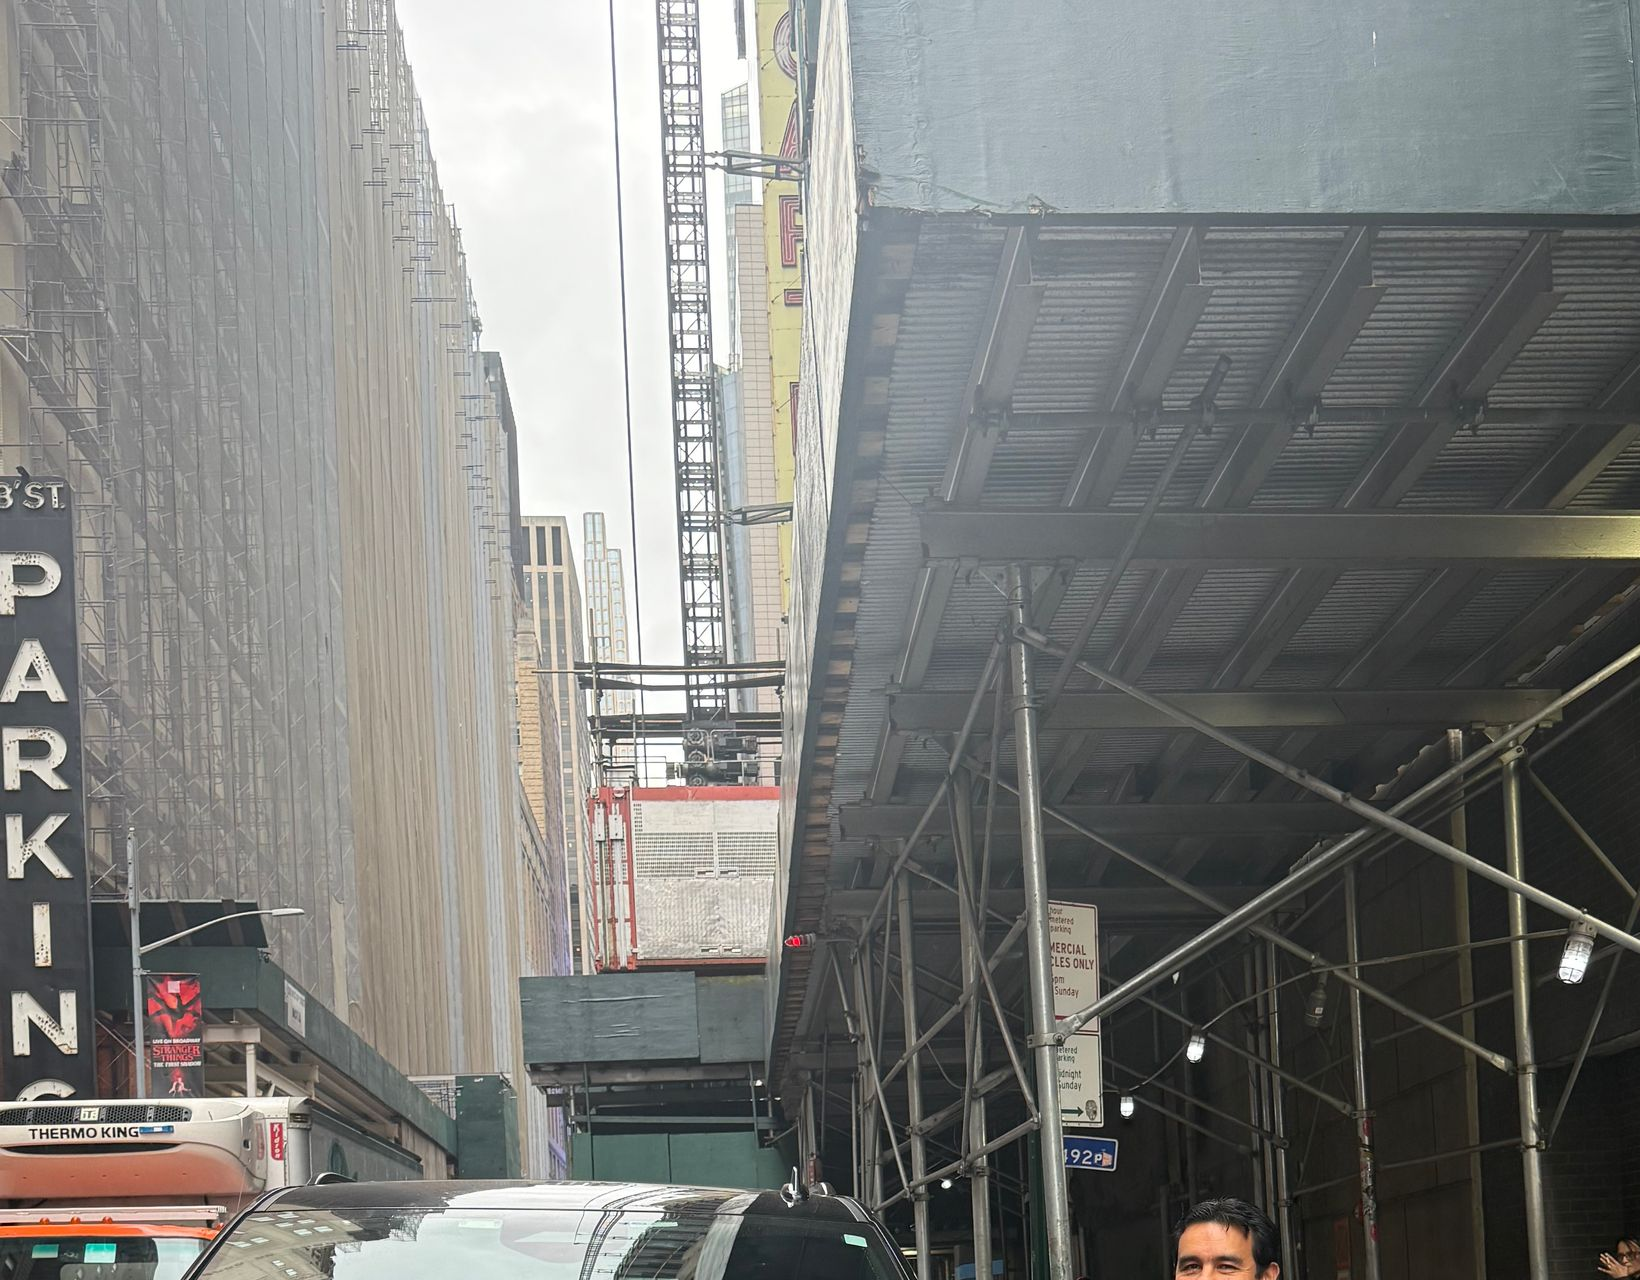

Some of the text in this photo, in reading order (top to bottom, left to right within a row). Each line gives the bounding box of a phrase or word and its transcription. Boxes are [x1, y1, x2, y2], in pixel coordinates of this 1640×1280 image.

[0, 551, 79, 1101] PARKIN
[1050, 942, 1087, 956] MERCIAL
[1051, 956, 1095, 970] CLES ONLY
[1054, 986, 1079, 998] Sunday
[152, 1045, 200, 1056] STRANGER
[162, 1054, 193, 1062] THINGS
[28, 1126, 140, 1140] THERMO KING
